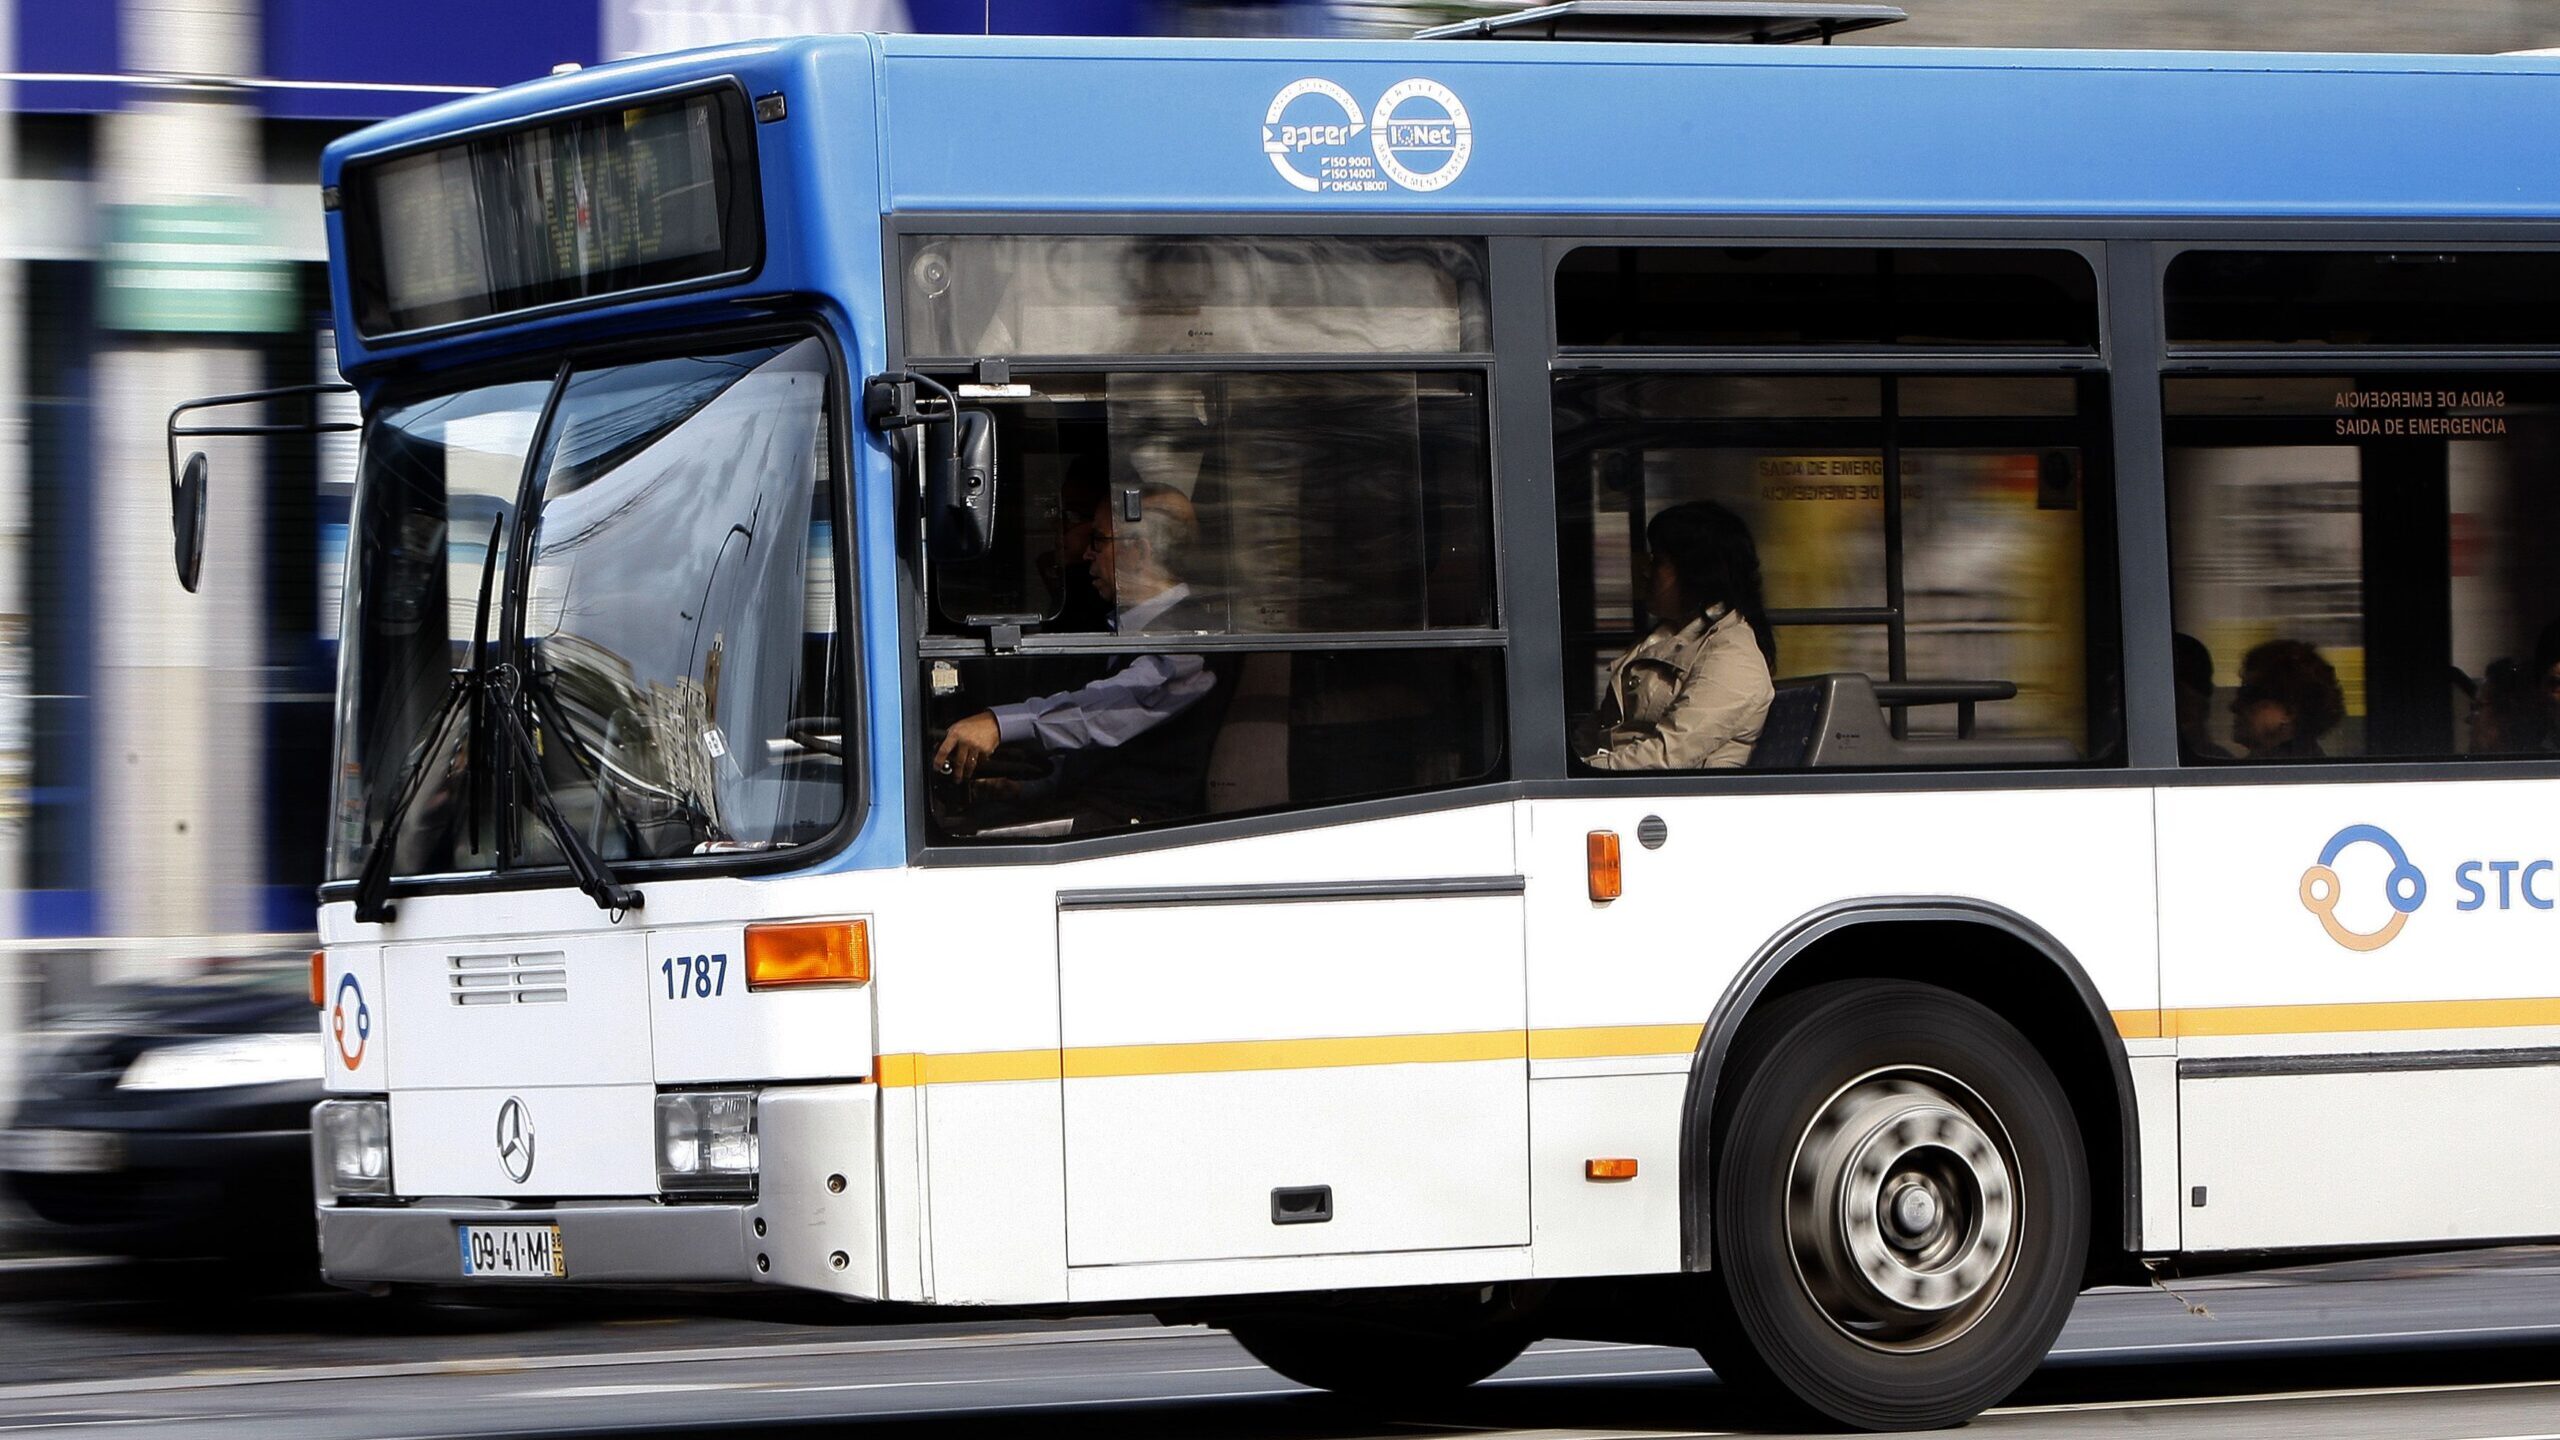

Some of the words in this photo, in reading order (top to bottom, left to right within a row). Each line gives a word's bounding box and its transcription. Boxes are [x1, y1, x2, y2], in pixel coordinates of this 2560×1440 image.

[1282, 125, 1348, 152] apcer
[1390, 125, 1451, 146] IQNet
[1331, 156, 1347, 167] ISO
[1348, 156, 1371, 167] 9001
[1331, 168, 1348, 179] ISO
[1349, 168, 1375, 179] 14001
[1331, 181, 1362, 192] OHSAS
[1363, 181, 1388, 191] 18001
[2336, 419, 2381, 435] SAIDA
[2385, 418, 2404, 434] DE
[2409, 418, 2506, 434] EMERGENCIA
[662, 954, 727, 1000] 1787
[472, 1232, 550, 1271] 09-41-MI
